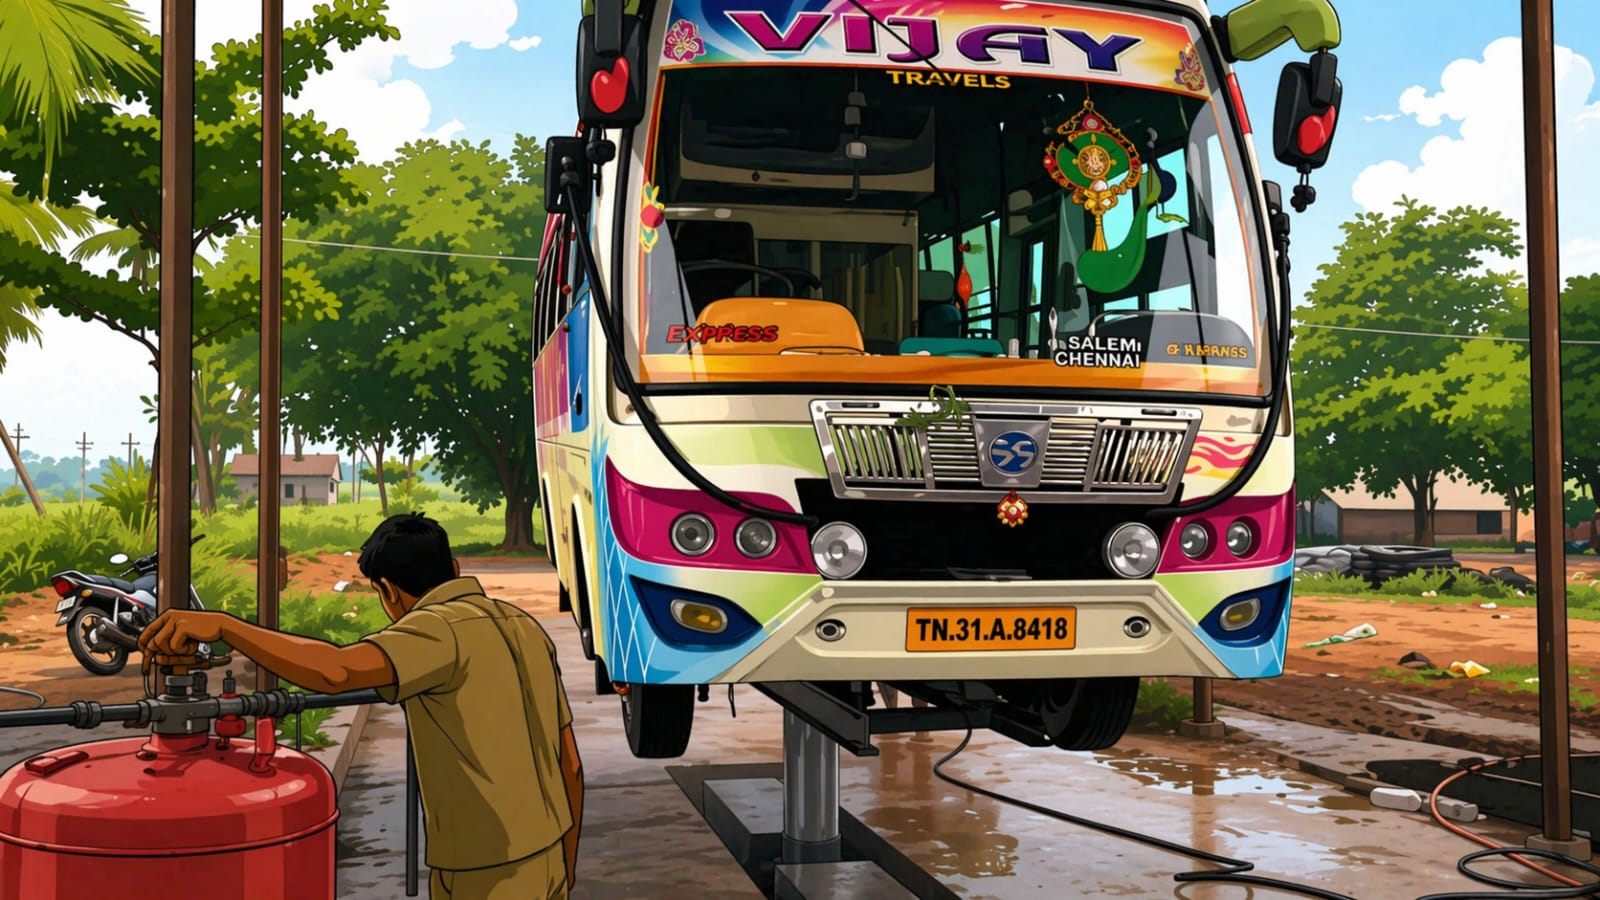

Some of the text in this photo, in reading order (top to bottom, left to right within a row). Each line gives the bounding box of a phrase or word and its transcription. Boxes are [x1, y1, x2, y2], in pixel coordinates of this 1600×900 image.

[724, 11, 1144, 74] VIJAY
[886, 69, 1012, 89] TRAVELS
[666, 324, 779, 344] EXPRESS
[1055, 351, 1140, 368] CHENNAI
[916, 617, 1068, 642] TN.31.A.8418
